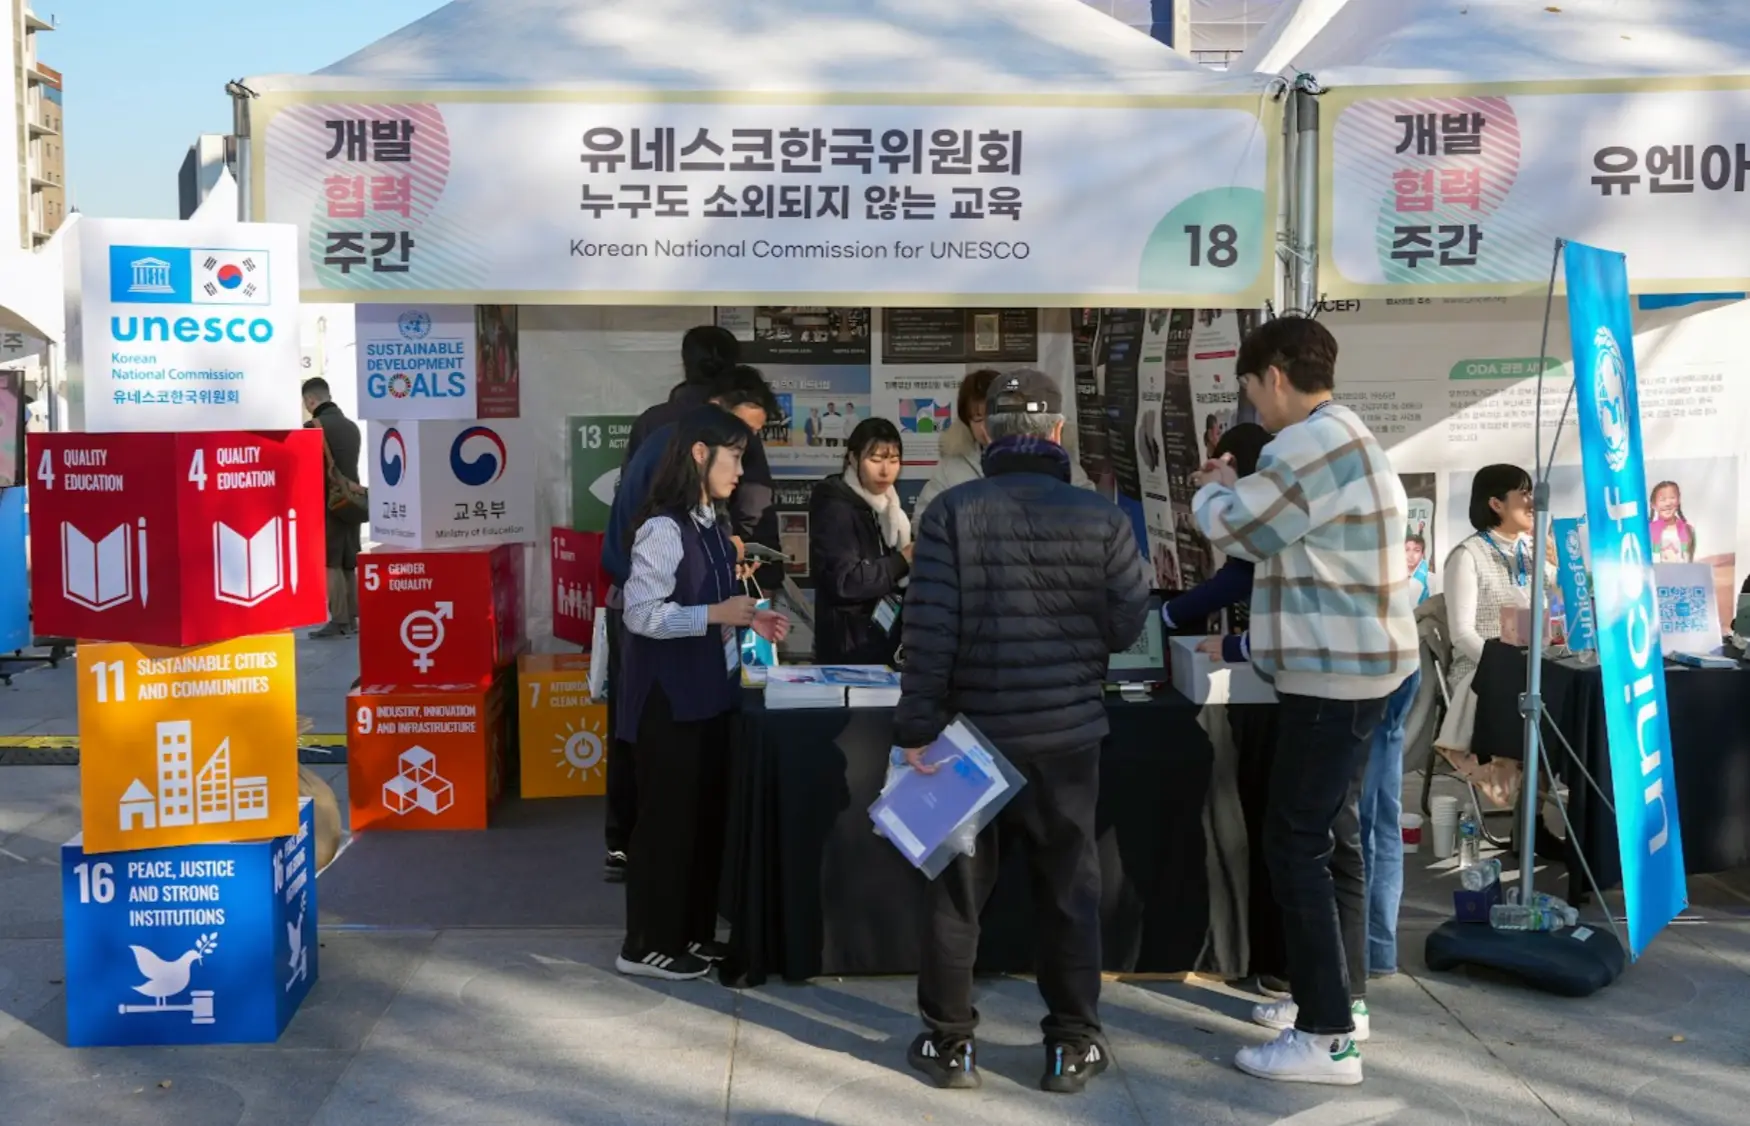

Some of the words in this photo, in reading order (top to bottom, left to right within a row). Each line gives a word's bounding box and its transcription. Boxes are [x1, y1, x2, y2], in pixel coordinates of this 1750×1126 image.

[325, 119, 415, 161] 개발
[1394, 112, 1486, 156] 개발
[580, 126, 1023, 176] 유네스코한국위원회
[1590, 143, 1750, 196] 유엔아
[324, 173, 413, 218] 협력
[1392, 166, 1483, 212] 협력
[580, 184, 690, 219] 누구도
[703, 184, 850, 220] 소외되지
[864, 185, 936, 221] 않는
[949, 186, 1023, 221] 교육
[324, 231, 415, 273] 주간
[569, 239, 648, 258] Korean
[654, 239, 746, 258] National
[751, 239, 887, 259] Commission
[893, 240, 925, 259] for
[929, 241, 1030, 260] UNESCO
[1184, 224, 1239, 268] 18
[1390, 224, 1484, 268] 주간
[110, 315, 273, 343] unesco
[111, 352, 157, 364] Korean
[366, 342, 464, 356] SUSTAINABLE
[111, 368, 166, 380] National
[167, 368, 244, 380] Commission
[366, 357, 465, 371] DEVELOPMENT
[113, 390, 240, 405] 유네스코한국위원회
[367, 372, 466, 399] GOALS
[578, 425, 601, 449] 13
[37, 449, 56, 490] 4
[64, 449, 107, 467] QUALITY
[188, 448, 208, 491] 4
[216, 446, 261, 467] QUALITY
[64, 474, 124, 491] EDUCATION
[217, 470, 276, 490] EDUCATION
[453, 501, 507, 520] 교육부
[435, 528, 470, 540] Ministry
[482, 525, 524, 537] Education
[364, 564, 380, 591] 5
[388, 563, 425, 575] GENDER
[389, 578, 433, 591] EQUALITY
[1567, 559, 1595, 640] unicef
[136, 654, 231, 676] SUSTAINABLE
[234, 651, 278, 670] CITIES
[1604, 486, 1668, 856] unicef
[90, 660, 126, 703] 11
[138, 683, 168, 701] AND
[171, 676, 270, 699] COMMUNITIES
[528, 682, 541, 709] 7
[356, 706, 373, 735] 9
[376, 722, 396, 734] AND
[397, 721, 477, 733] INFRASTRUCTURE
[73, 862, 115, 904] 16
[128, 861, 177, 881] PEACE,
[179, 860, 236, 878] JUSTICE
[129, 886, 159, 902] AND
[162, 884, 219, 901] STRONG
[129, 909, 226, 927] INSTITUTIONS
